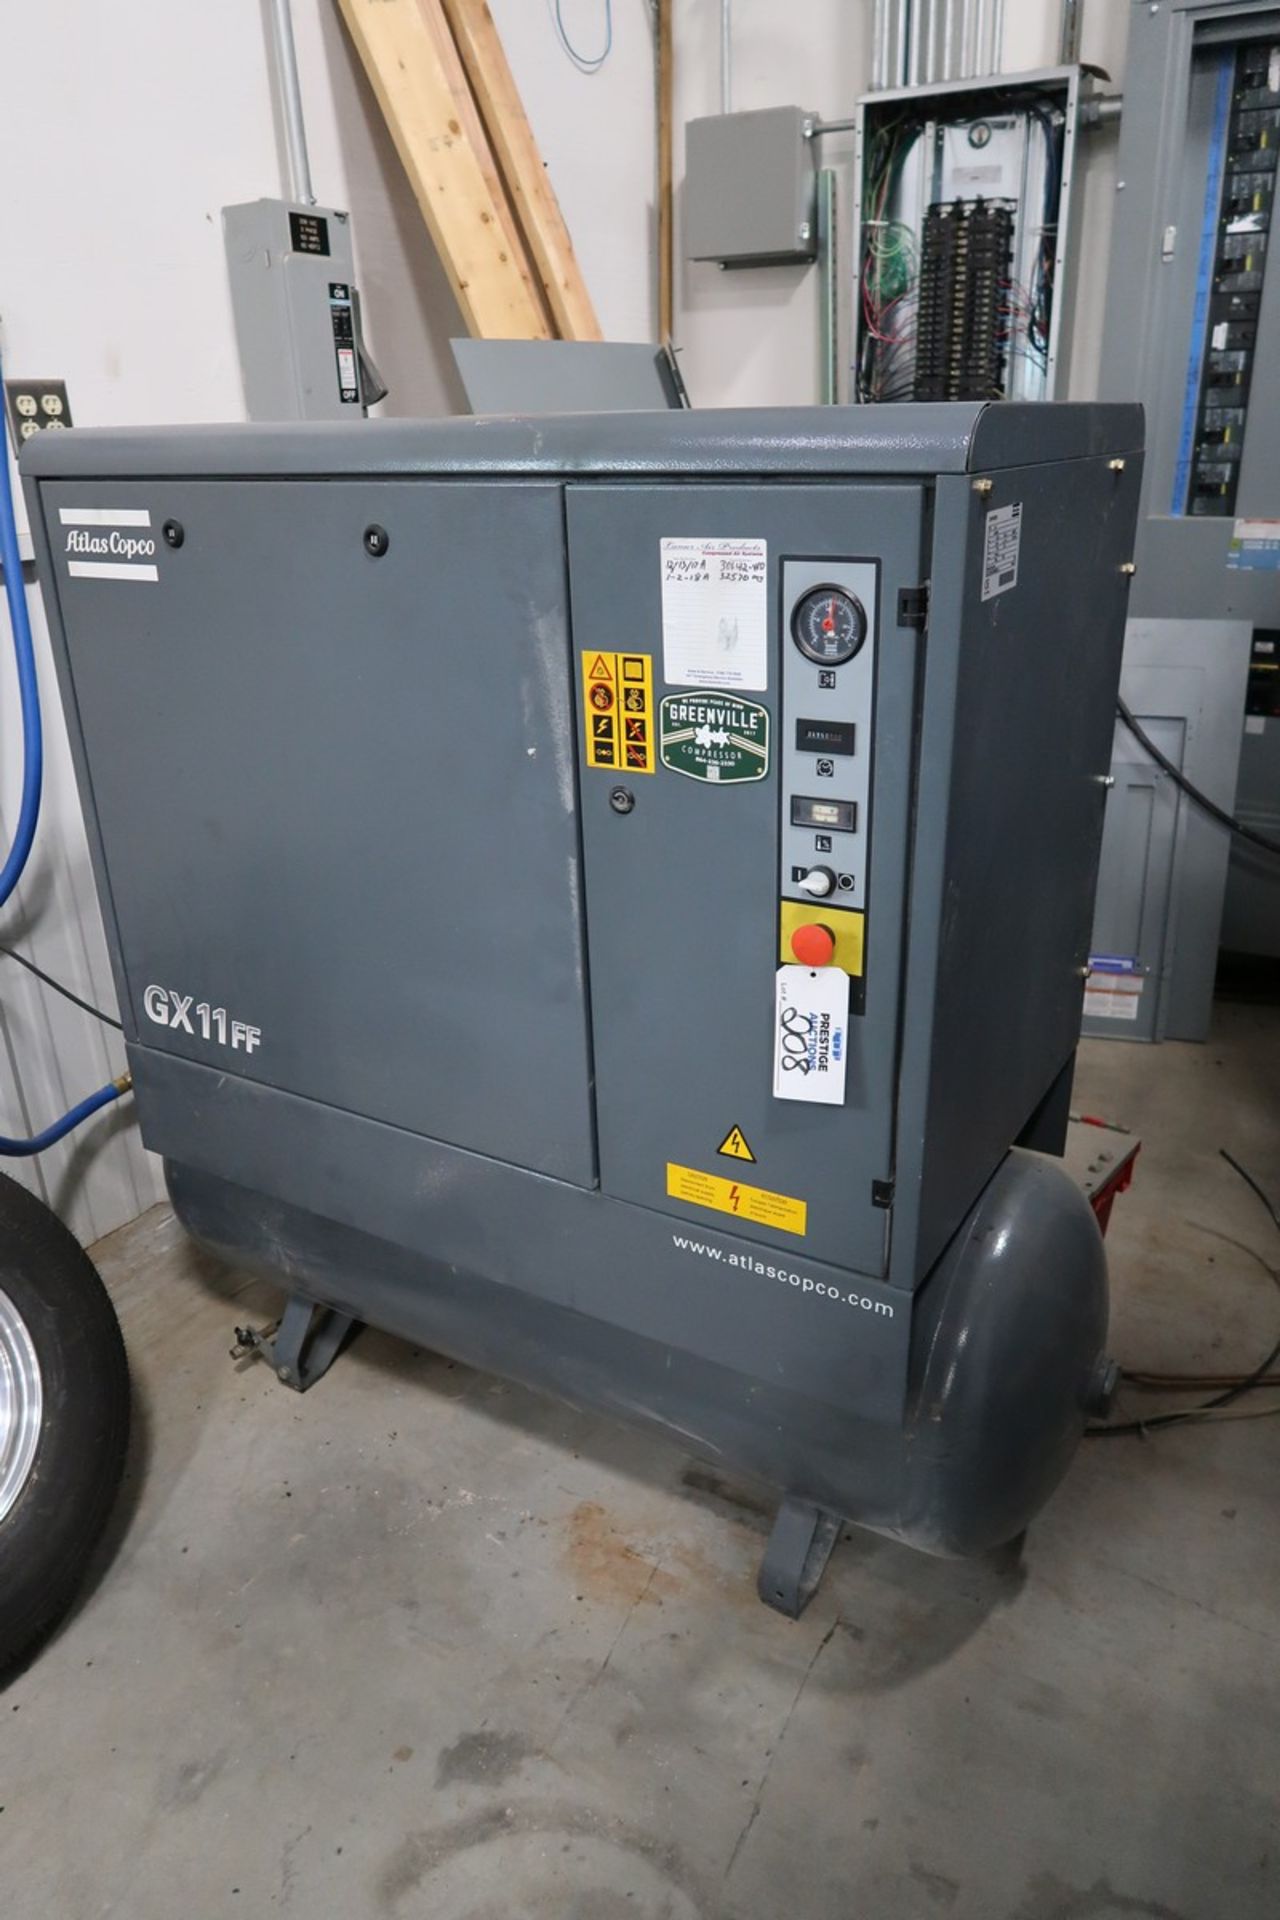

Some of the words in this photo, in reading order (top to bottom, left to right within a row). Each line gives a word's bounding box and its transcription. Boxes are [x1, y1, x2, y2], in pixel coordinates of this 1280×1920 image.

[343, 389, 356, 399] OFF
[65, 530, 109, 554] Atlas
[110, 532, 155, 559] Copco
[669, 704, 759, 729] GREENVILLE
[681, 745, 743, 759] COMPRESSOR
[780, 1007, 813, 1076] 208
[808, 1012, 818, 1071] AUCTIONS
[818, 1012, 831, 1072] PRESTIGE
[672, 1235, 895, 1319] www.atlascopco.com
